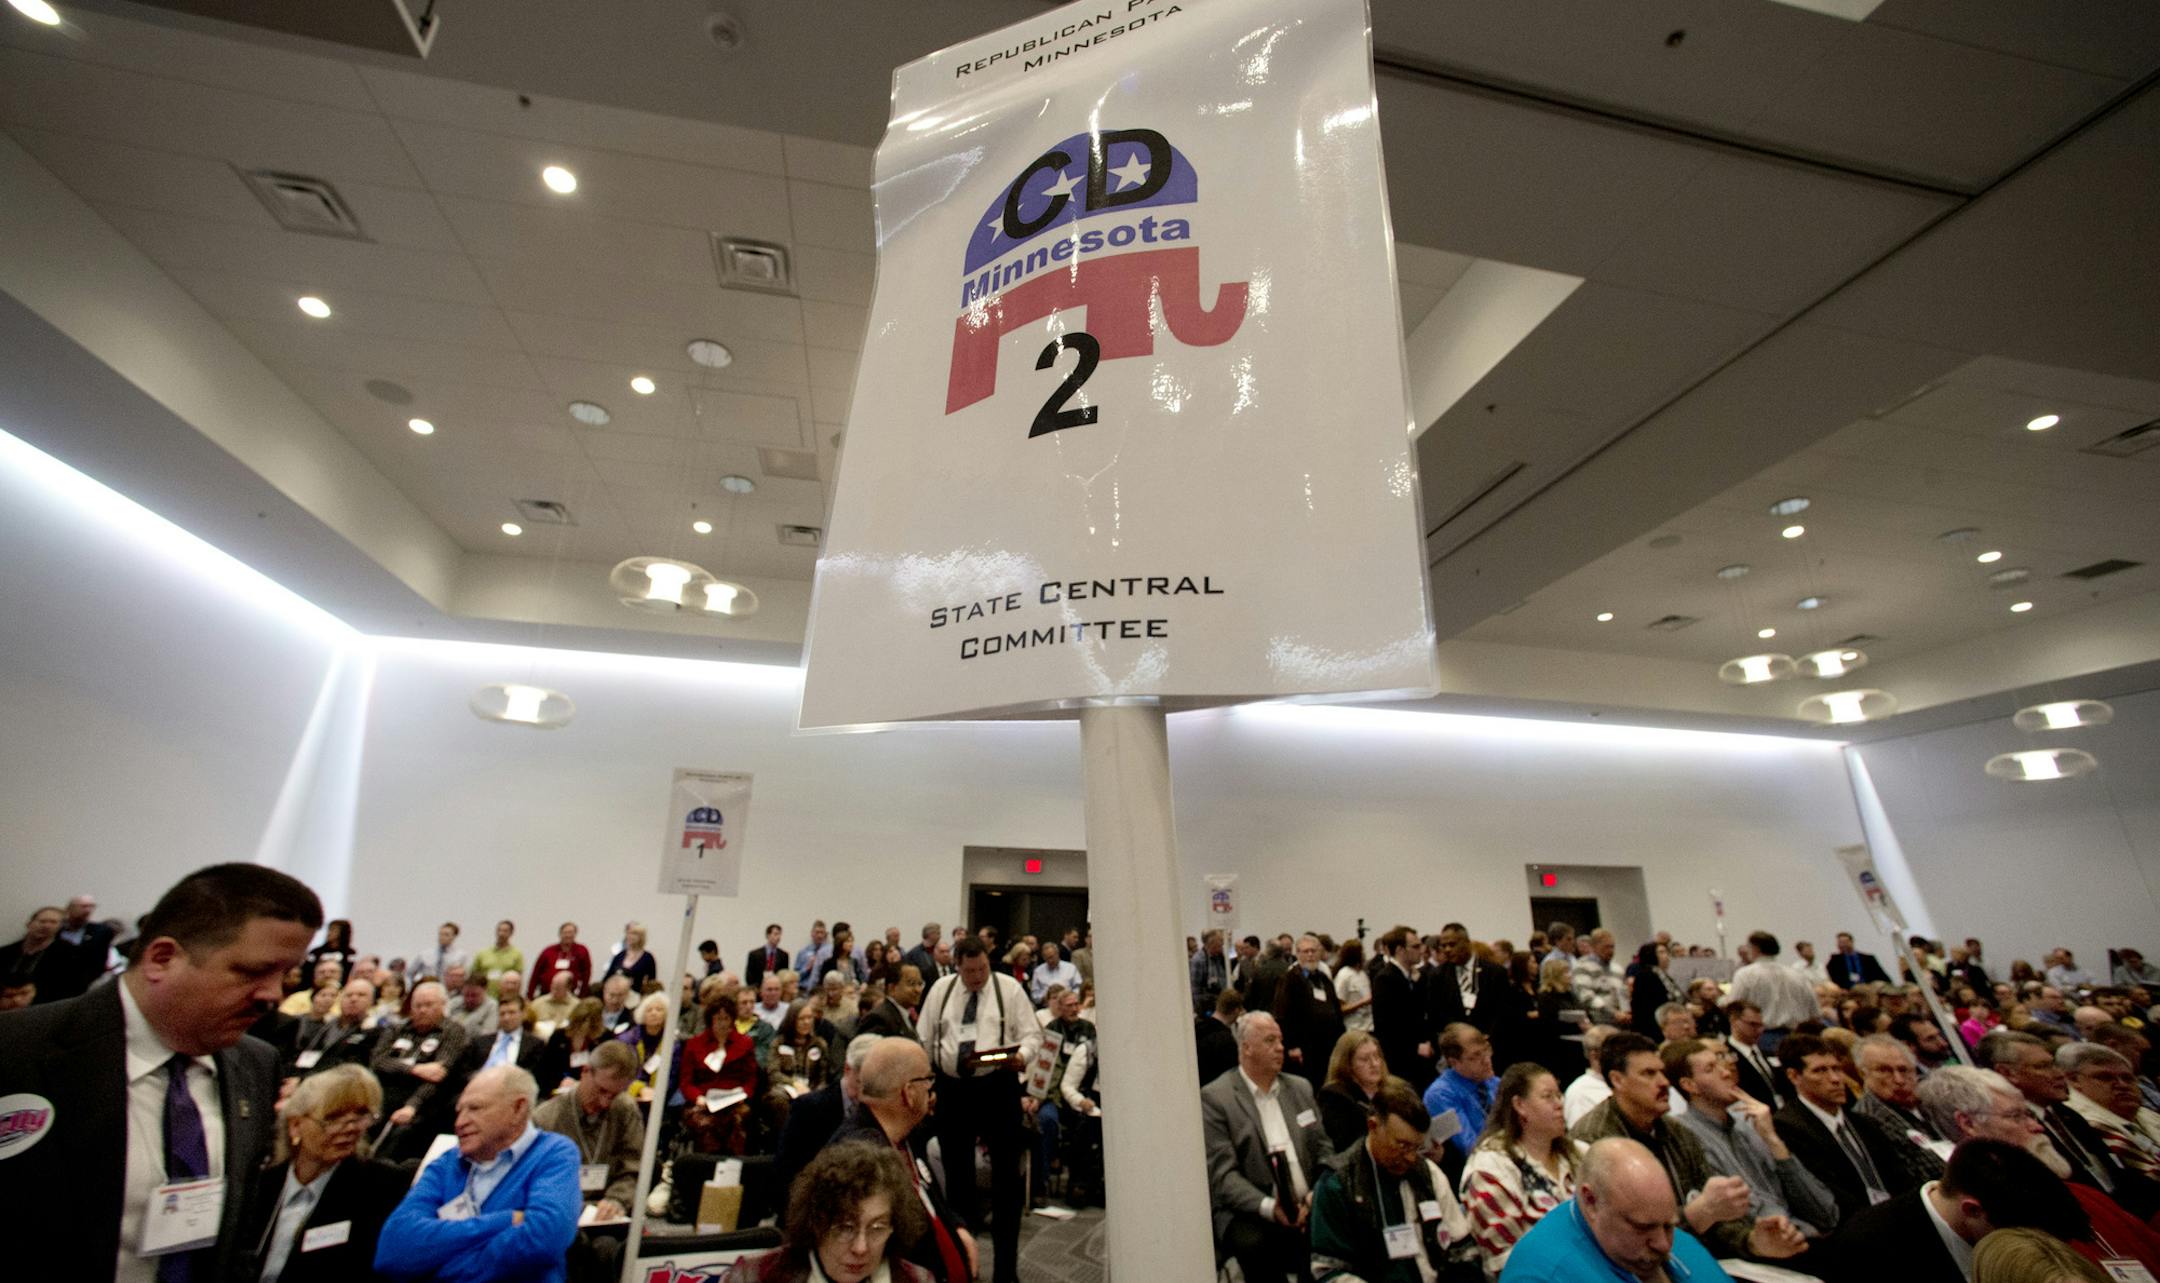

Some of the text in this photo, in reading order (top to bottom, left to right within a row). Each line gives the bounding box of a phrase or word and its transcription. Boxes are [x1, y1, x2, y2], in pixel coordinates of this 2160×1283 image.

[956, 10, 1112, 78] REPUBLICAN
[1023, 5, 1182, 72] MINNESOTA
[1003, 129, 1173, 240] CD
[961, 213, 1191, 309] Minnesota
[1028, 331, 1101, 439] 2
[930, 576, 1225, 629] STATE CENTRAL
[960, 619, 1168, 660] COMMITTEE
[697, 843, 705, 859] 1
